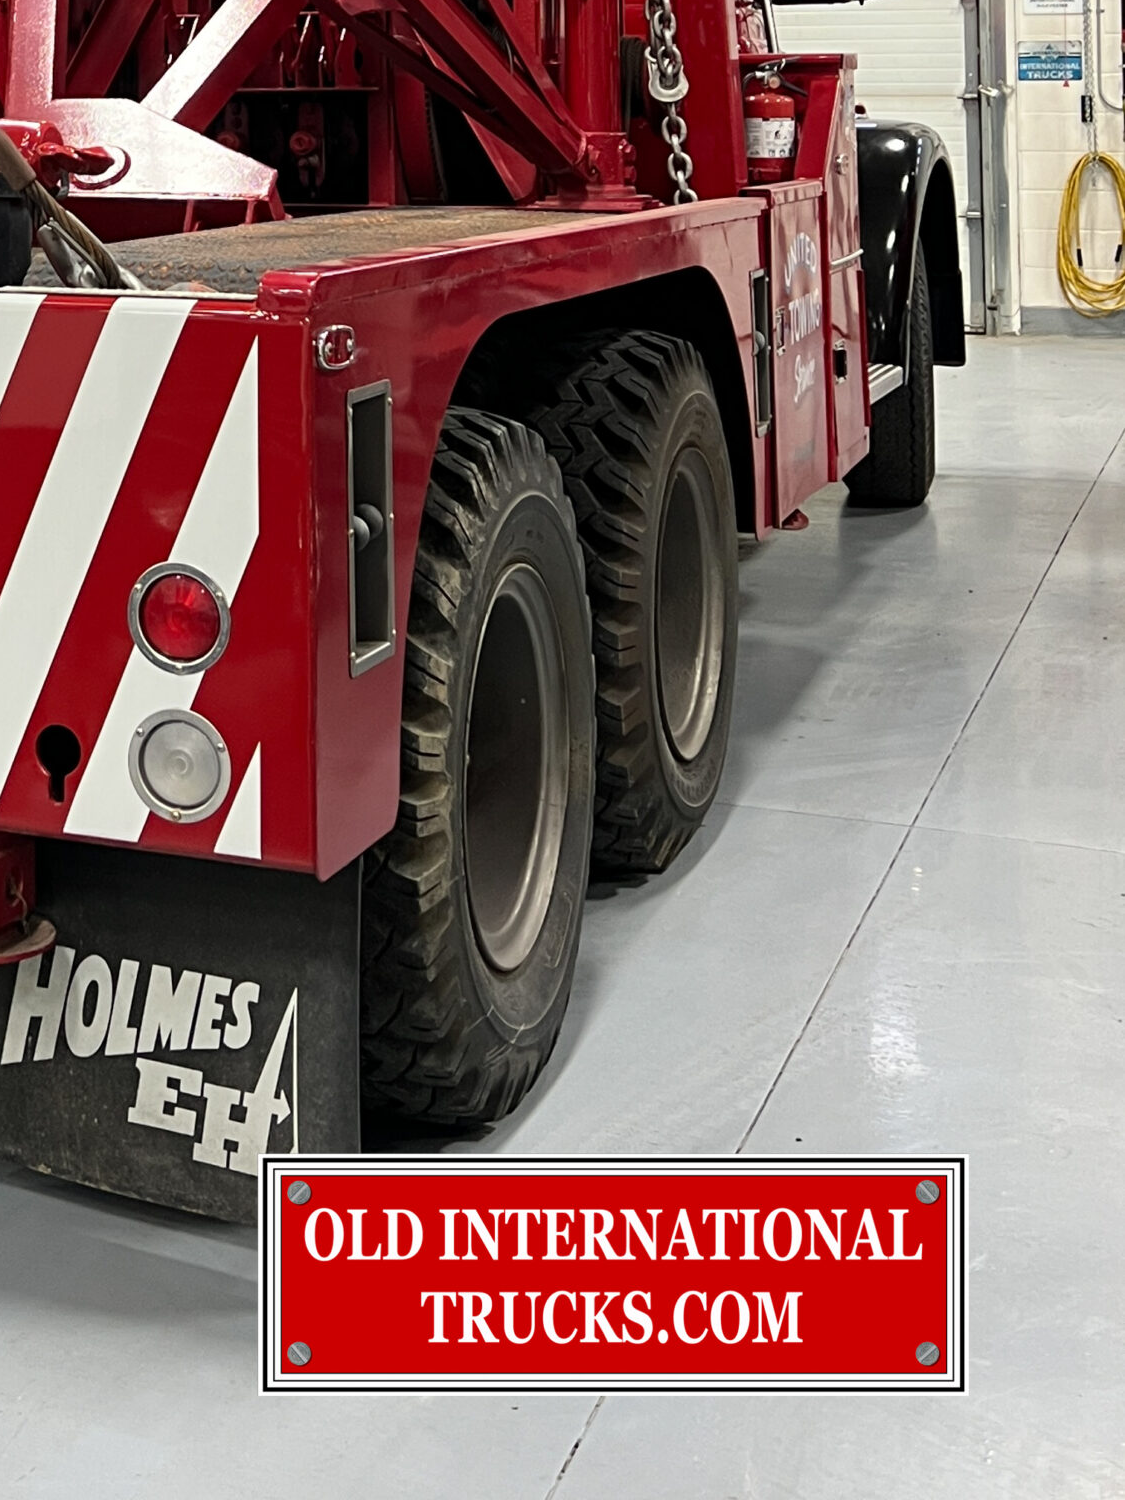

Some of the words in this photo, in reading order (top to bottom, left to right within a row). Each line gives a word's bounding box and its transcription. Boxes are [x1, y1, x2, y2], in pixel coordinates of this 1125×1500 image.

[1019, 62, 1081, 71] INTERNATIONAL
[1027, 70, 1074, 79] TRUCKS
[784, 232, 817, 290] UNITED
[788, 287, 821, 345] TOWING
[0, 944, 261, 1066] HOLMES
